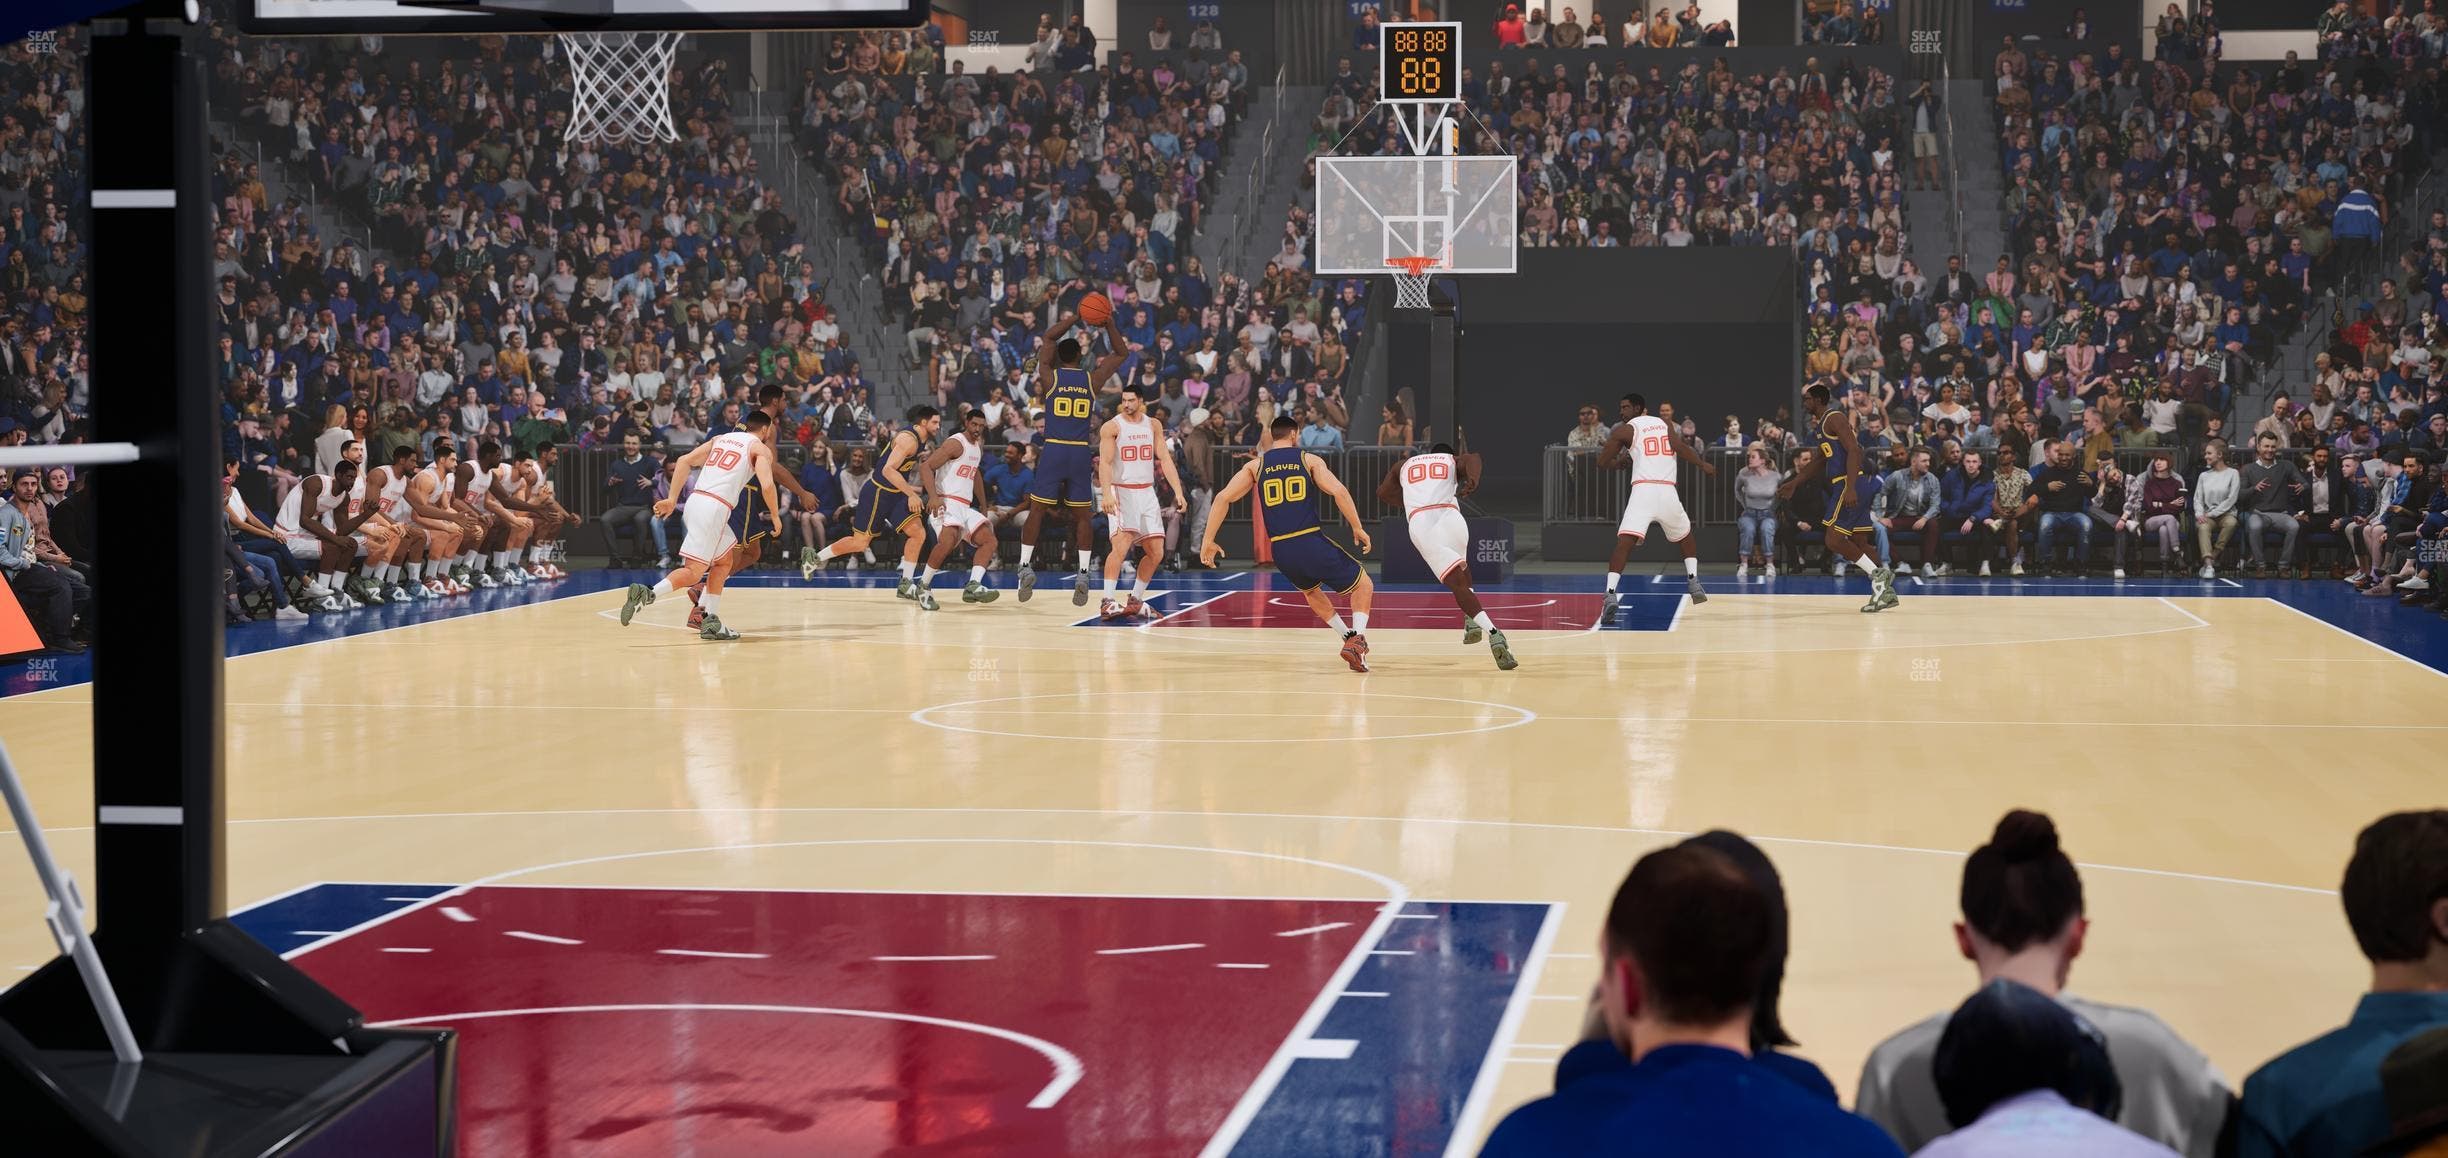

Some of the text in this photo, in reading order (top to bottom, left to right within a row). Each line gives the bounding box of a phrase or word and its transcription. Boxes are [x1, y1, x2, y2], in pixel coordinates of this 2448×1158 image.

[1189, 4, 1218, 16] 128
[1395, 31, 1447, 52] 88 88
[1401, 57, 1440, 94] 88
[1058, 386, 1088, 394] PLAYER
[1053, 397, 1091, 418] 00
[705, 448, 741, 470] 00
[1121, 444, 1153, 461] 00
[1265, 463, 1300, 474] PLAYER
[1408, 462, 1448, 484] 00
[1263, 475, 1307, 507] 00
